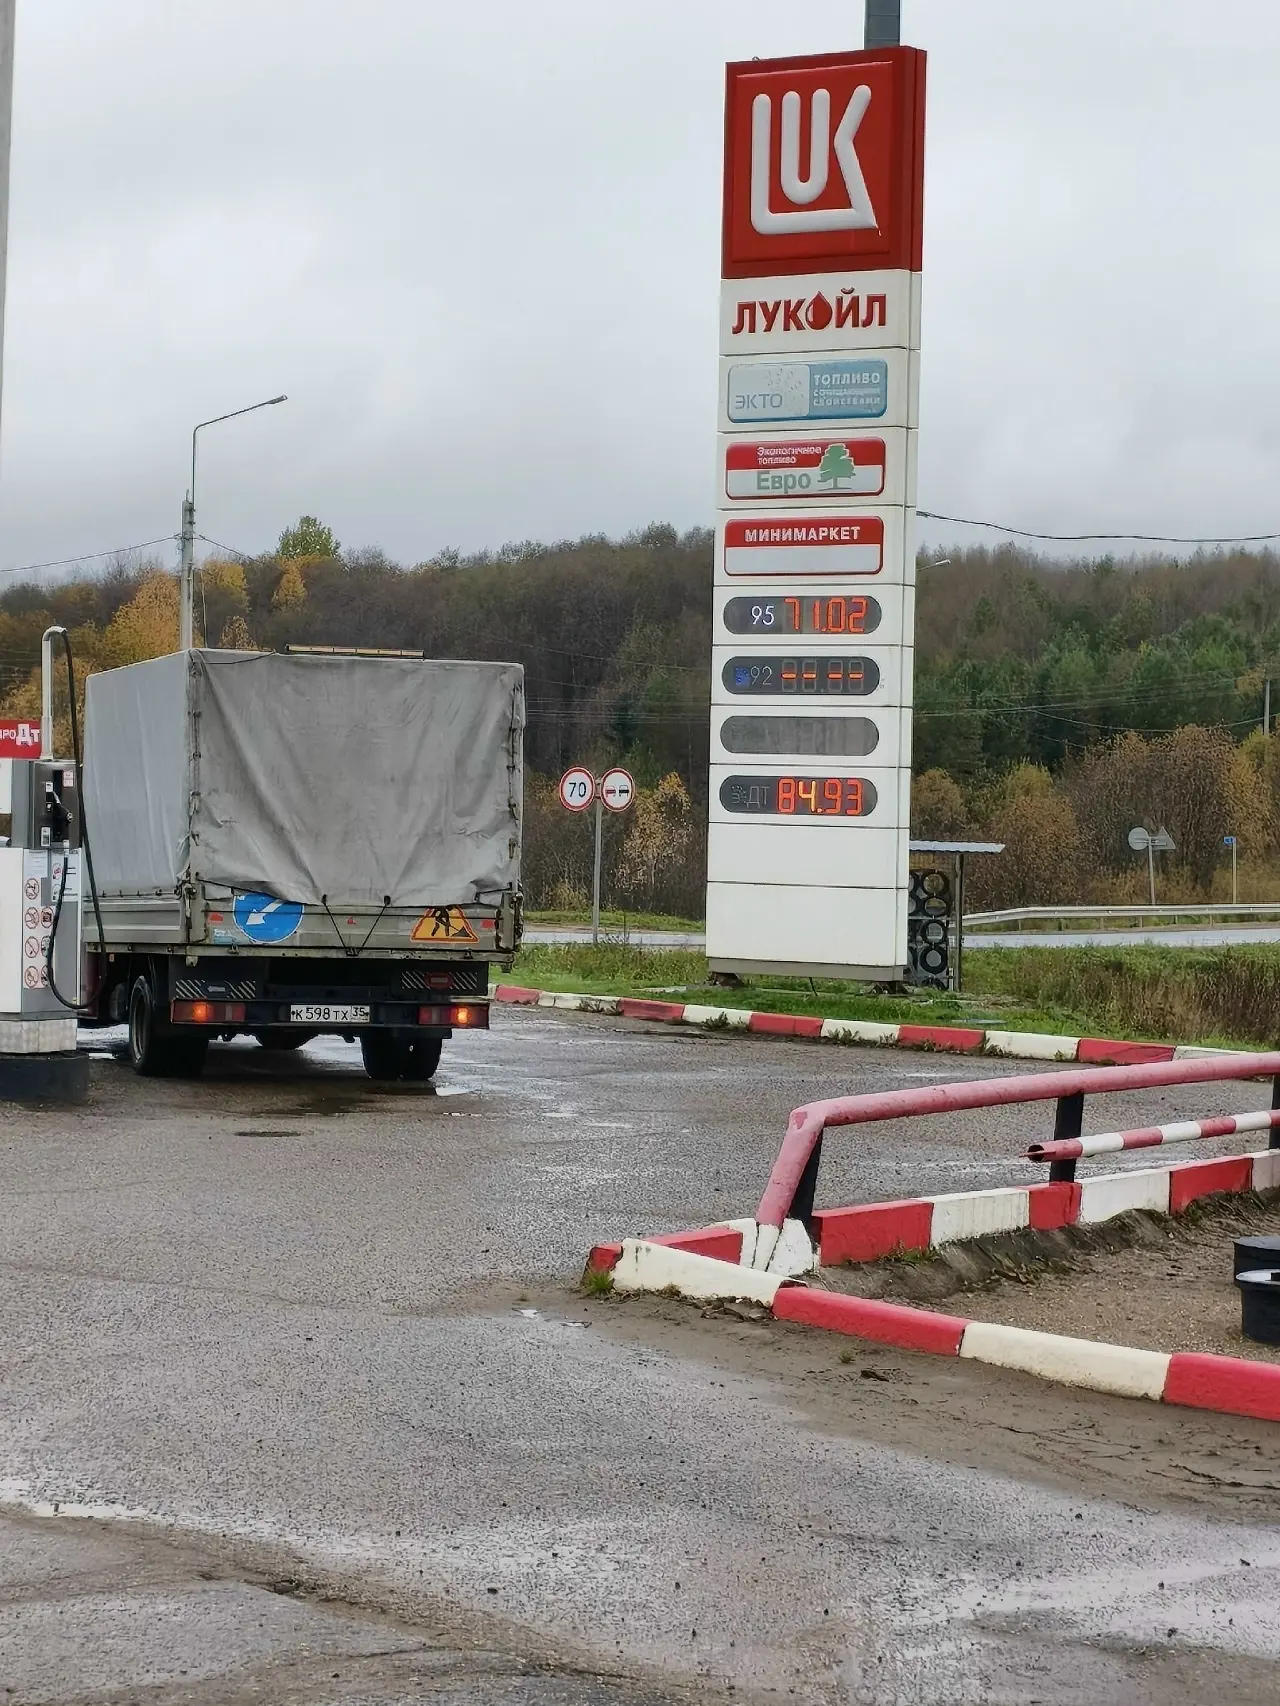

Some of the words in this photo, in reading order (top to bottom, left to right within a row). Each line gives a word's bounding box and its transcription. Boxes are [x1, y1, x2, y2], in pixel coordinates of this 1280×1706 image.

[732, 287, 887, 334] ЛУКОЙЛ
[813, 372, 881, 386] ТОПЛИВО
[735, 393, 784, 410] ЭКТО
[757, 470, 812, 494] Евро
[744, 526, 861, 542] МИНИМАРКЕТ
[751, 605, 775, 626] 95
[784, 597, 868, 634] 71.02
[750, 665, 773, 686] 92
[568, 782, 587, 798] 70
[777, 777, 863, 816] 84.93
